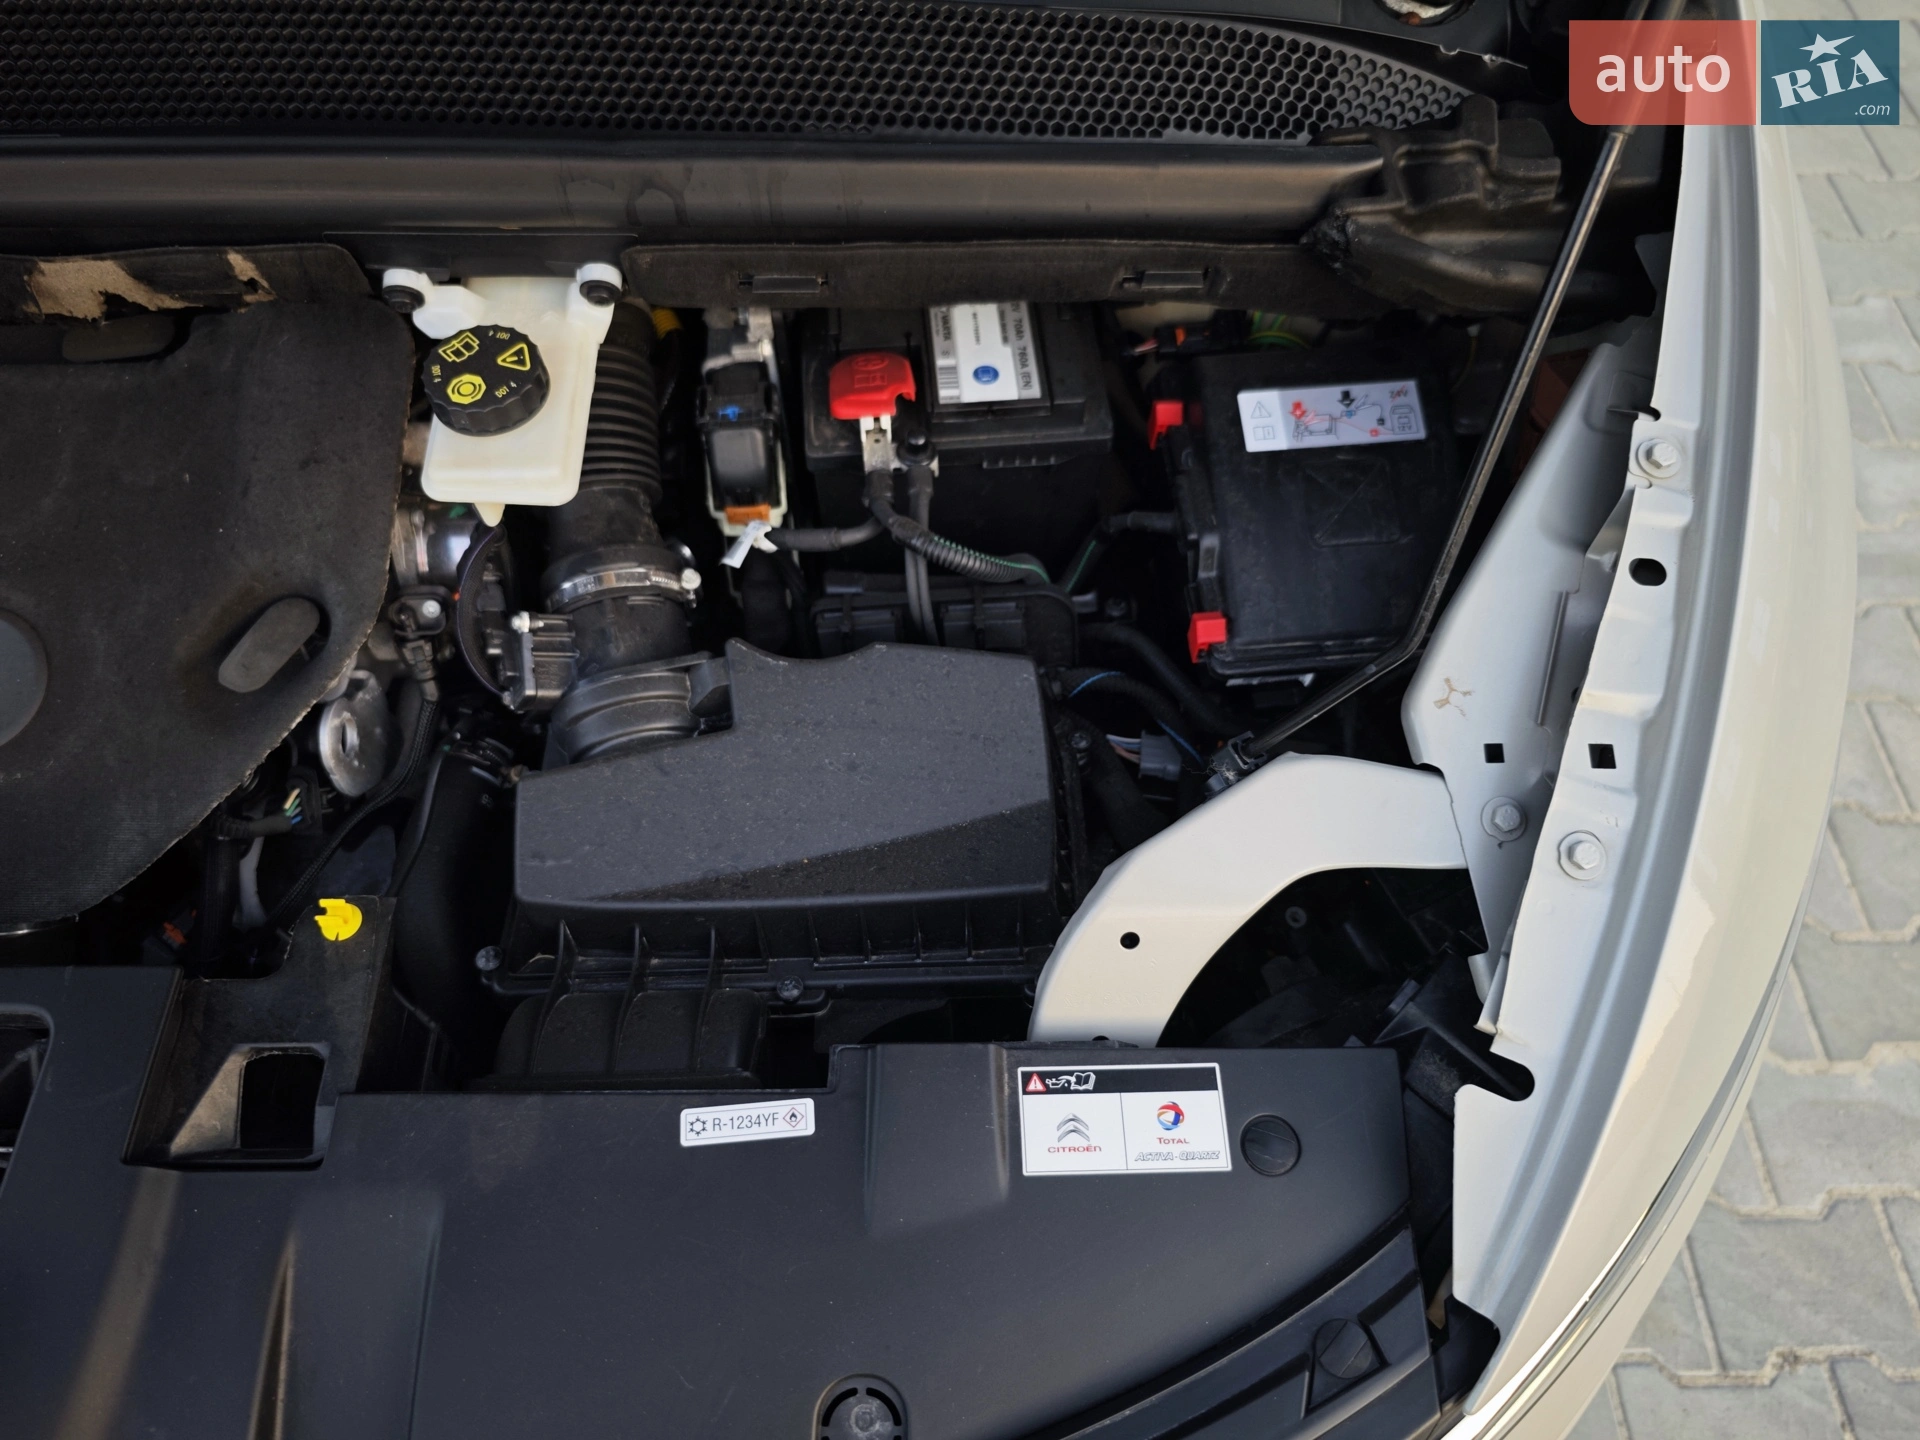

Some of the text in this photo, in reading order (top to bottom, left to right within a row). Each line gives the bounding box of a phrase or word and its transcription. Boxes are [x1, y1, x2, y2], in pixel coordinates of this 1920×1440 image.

[496, 332, 511, 340] DOT
[941, 314, 952, 341] VARTA
[1013, 318, 1024, 341] 70Ah
[1017, 346, 1029, 369] 760A
[495, 385, 510, 398] DOT
[712, 1112, 780, 1132] R-1234YF
